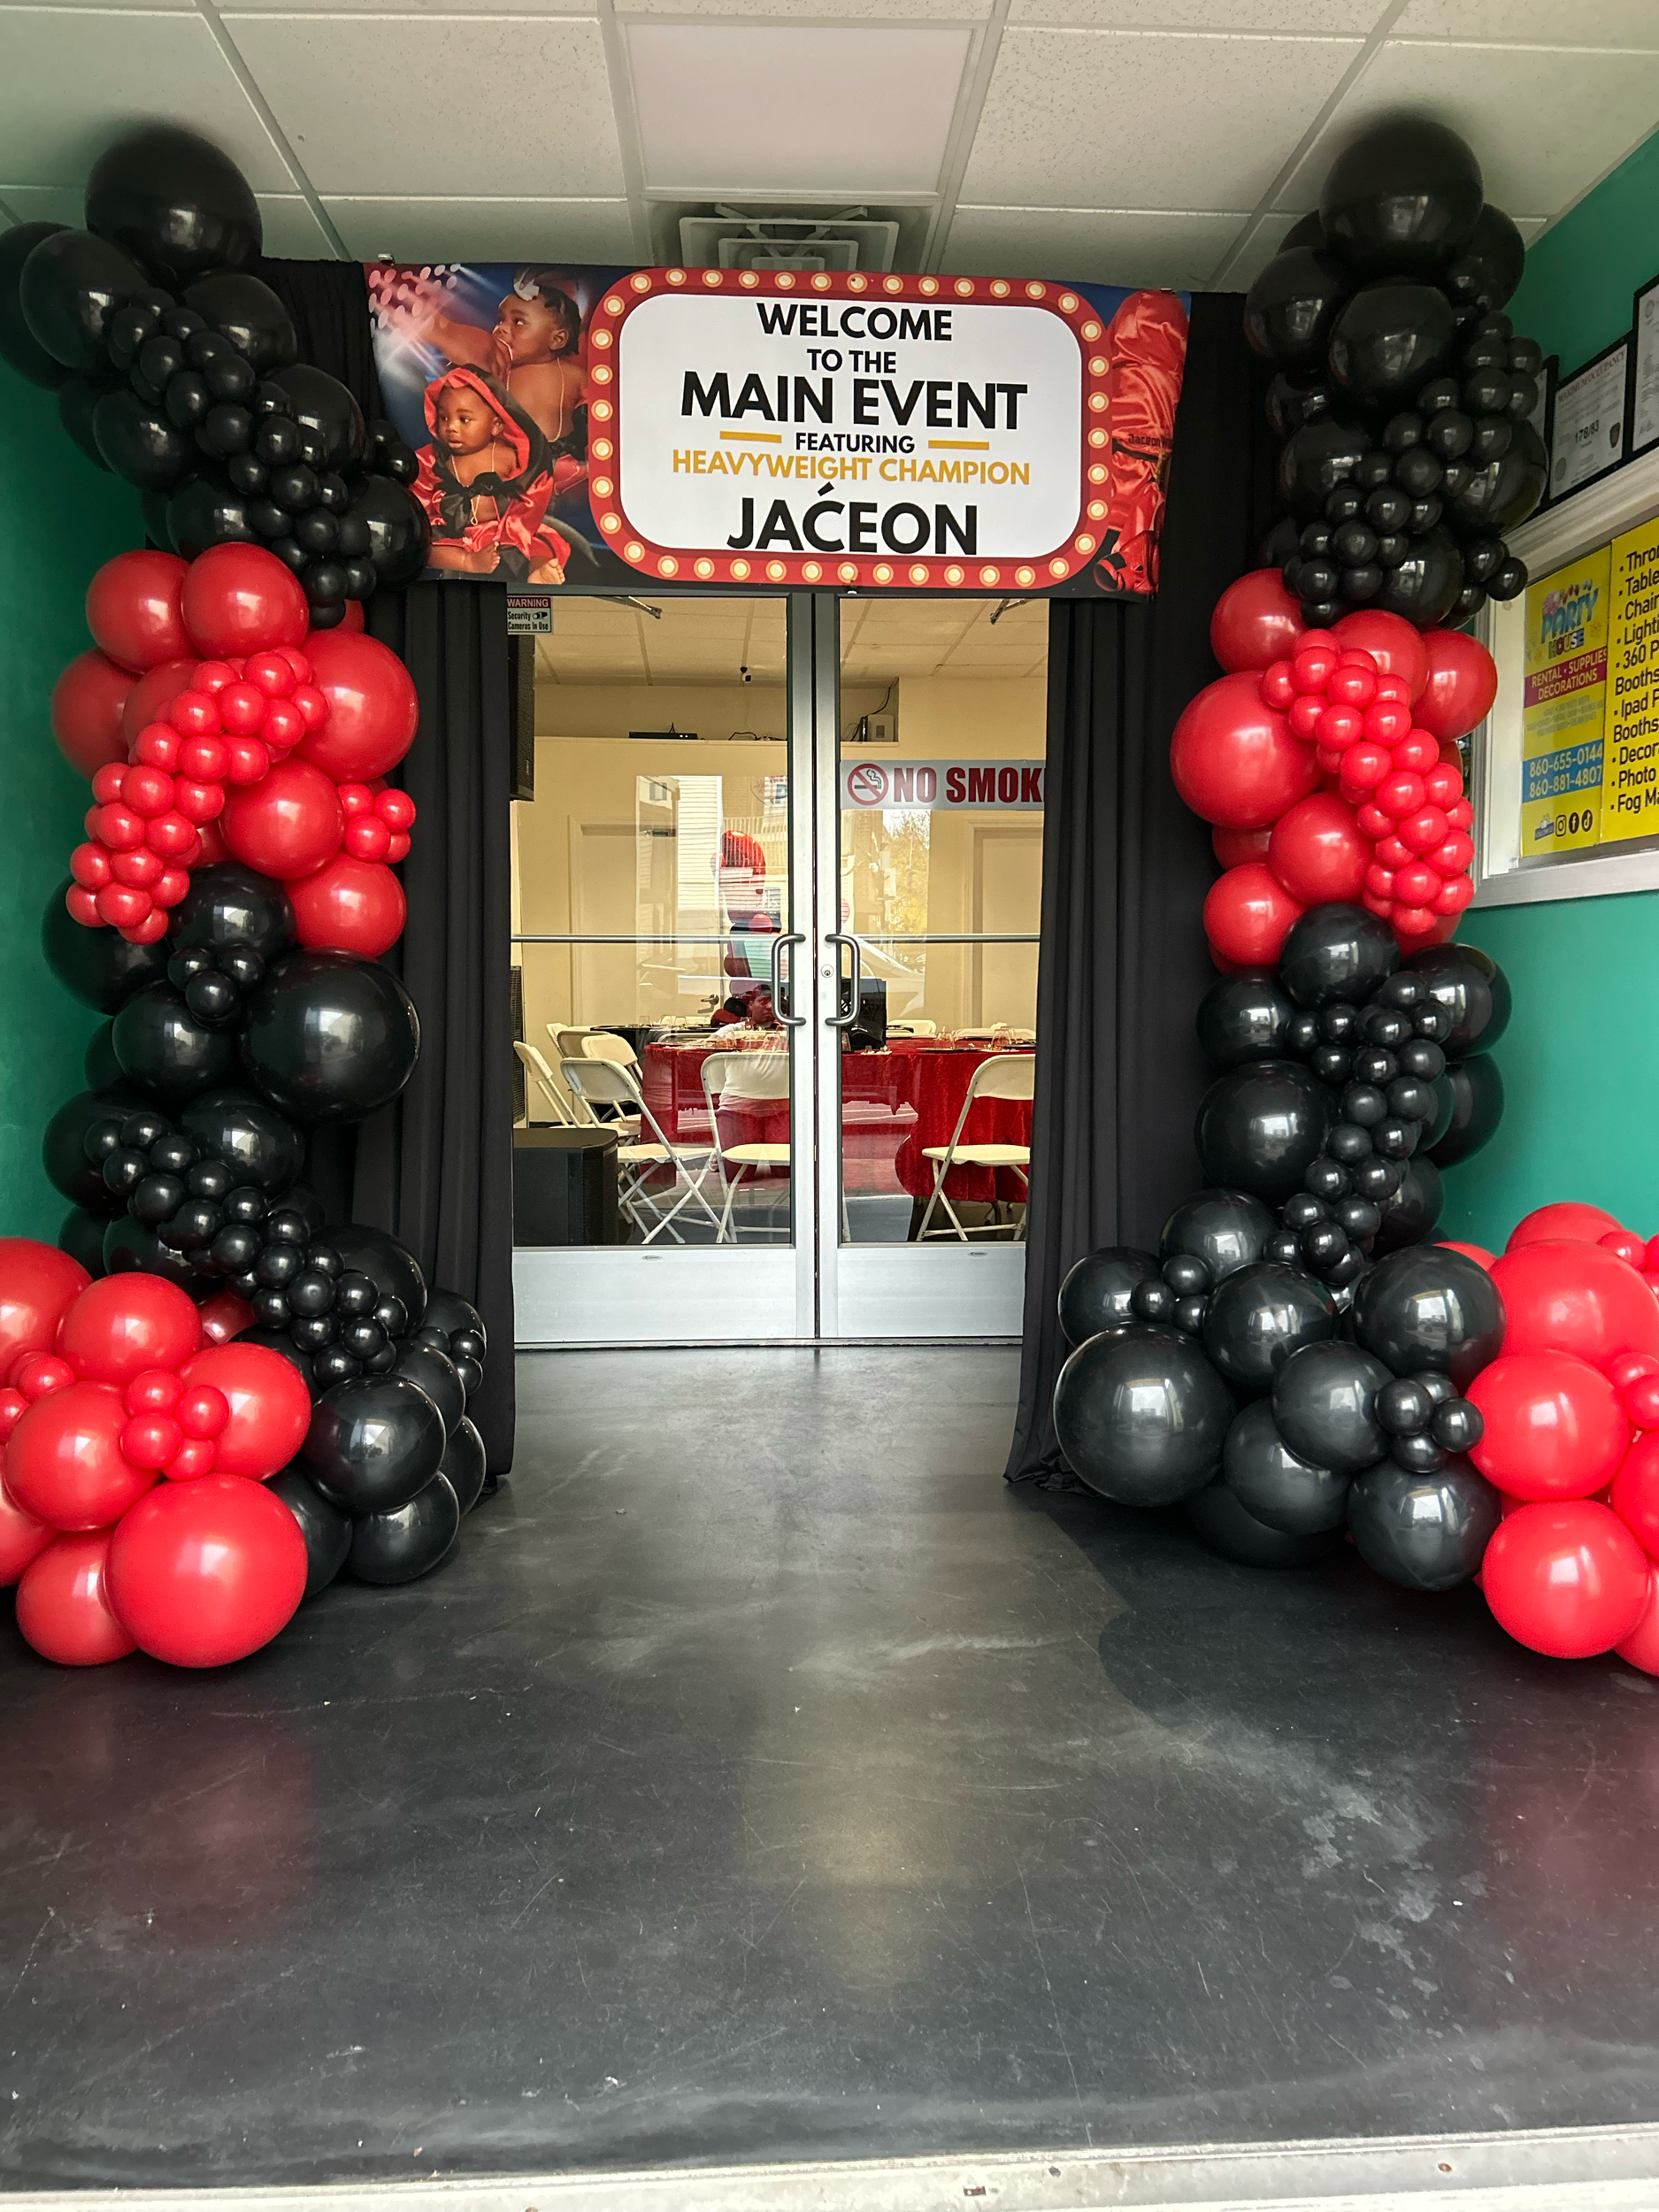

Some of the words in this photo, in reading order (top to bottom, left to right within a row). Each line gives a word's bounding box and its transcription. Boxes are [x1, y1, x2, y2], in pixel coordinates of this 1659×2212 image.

[757, 303, 952, 342] WELCOME
[806, 348, 842, 372] TO
[849, 349, 896, 374] THE
[680, 371, 833, 424] MAIN
[853, 379, 1027, 430] EVENT
[795, 432, 915, 454] FEATURING
[672, 449, 872, 482] HEAVYWEIGHT
[879, 458, 1031, 485] CHAMPION
[507, 598, 549, 608] WARNING
[508, 611, 531, 621] Security
[1540, 588, 1599, 645] PARTY
[508, 621, 531, 630] Cameras
[532, 621, 537, 630] In
[539, 621, 549, 630] Use
[1548, 627, 1585, 659] HOUSE
[1624, 643, 1646, 669] 360
[1532, 666, 1563, 688] RENTAL
[1538, 668, 1598, 700] DECORATIONS
[1615, 667, 1659, 696] Booths
[1621, 691, 1648, 721] Ipad
[1613, 717, 1659, 743] Booths
[1529, 743, 1603, 778] 860-655-0144
[894, 767, 937, 803] NO
[946, 767, 1045, 803] SMOK
[1529, 764, 1603, 798] 860-881-4807
[1618, 766, 1656, 788] Photo
[1617, 794, 1641, 814] Fog
